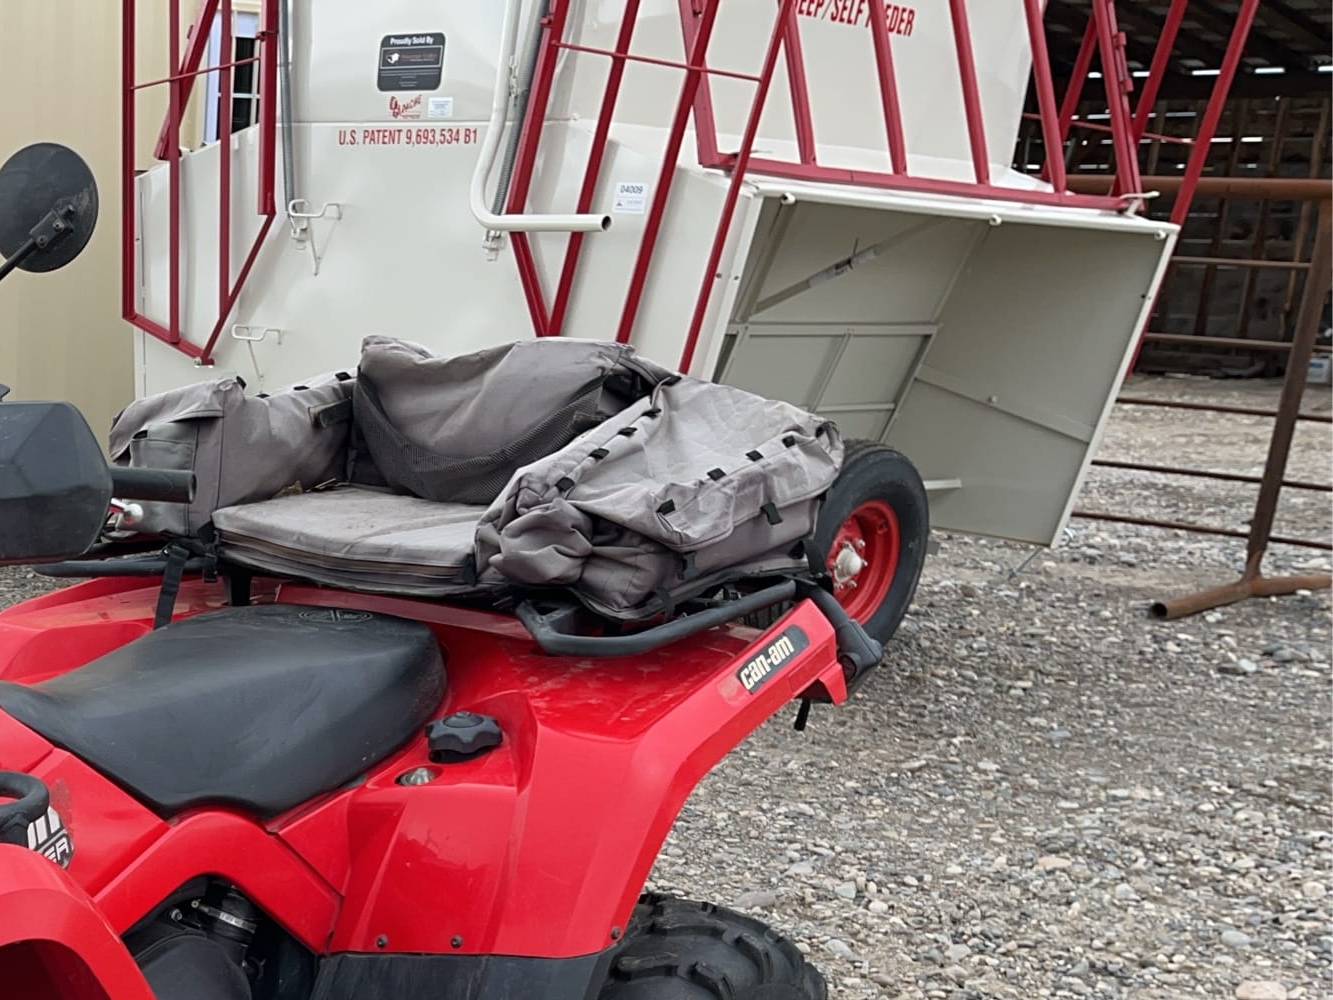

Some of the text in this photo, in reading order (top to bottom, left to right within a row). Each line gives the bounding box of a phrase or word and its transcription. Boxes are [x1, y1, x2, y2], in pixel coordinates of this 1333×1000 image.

[390, 35, 434, 46] Proudly Sold By
[338, 127, 477, 148] U.S. PATENT 9,693,534 B1
